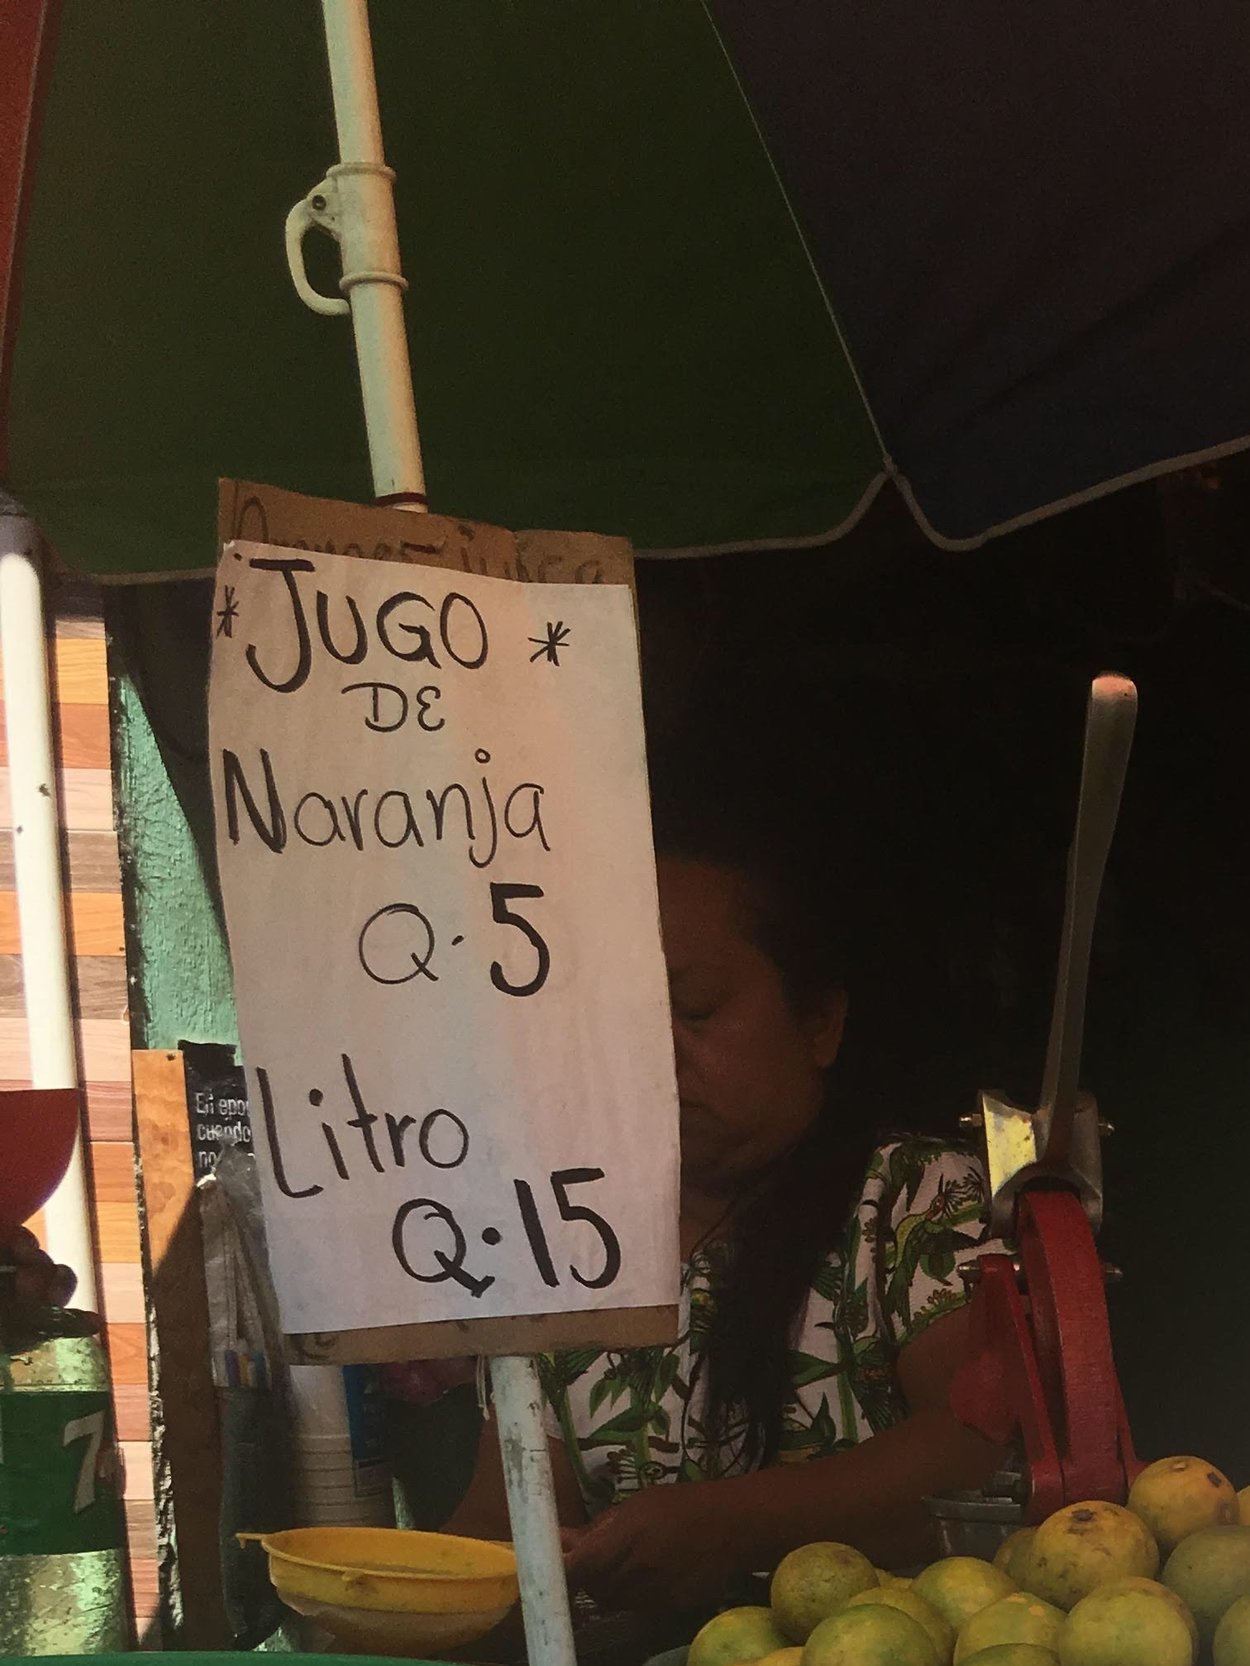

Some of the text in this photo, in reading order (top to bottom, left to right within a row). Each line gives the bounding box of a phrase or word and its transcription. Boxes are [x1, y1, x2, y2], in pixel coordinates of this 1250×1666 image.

[246, 557, 489, 693] JUGO
[341, 682, 446, 733] DE
[222, 748, 551, 869] Naranja
[255, 1053, 469, 1199] Litro
